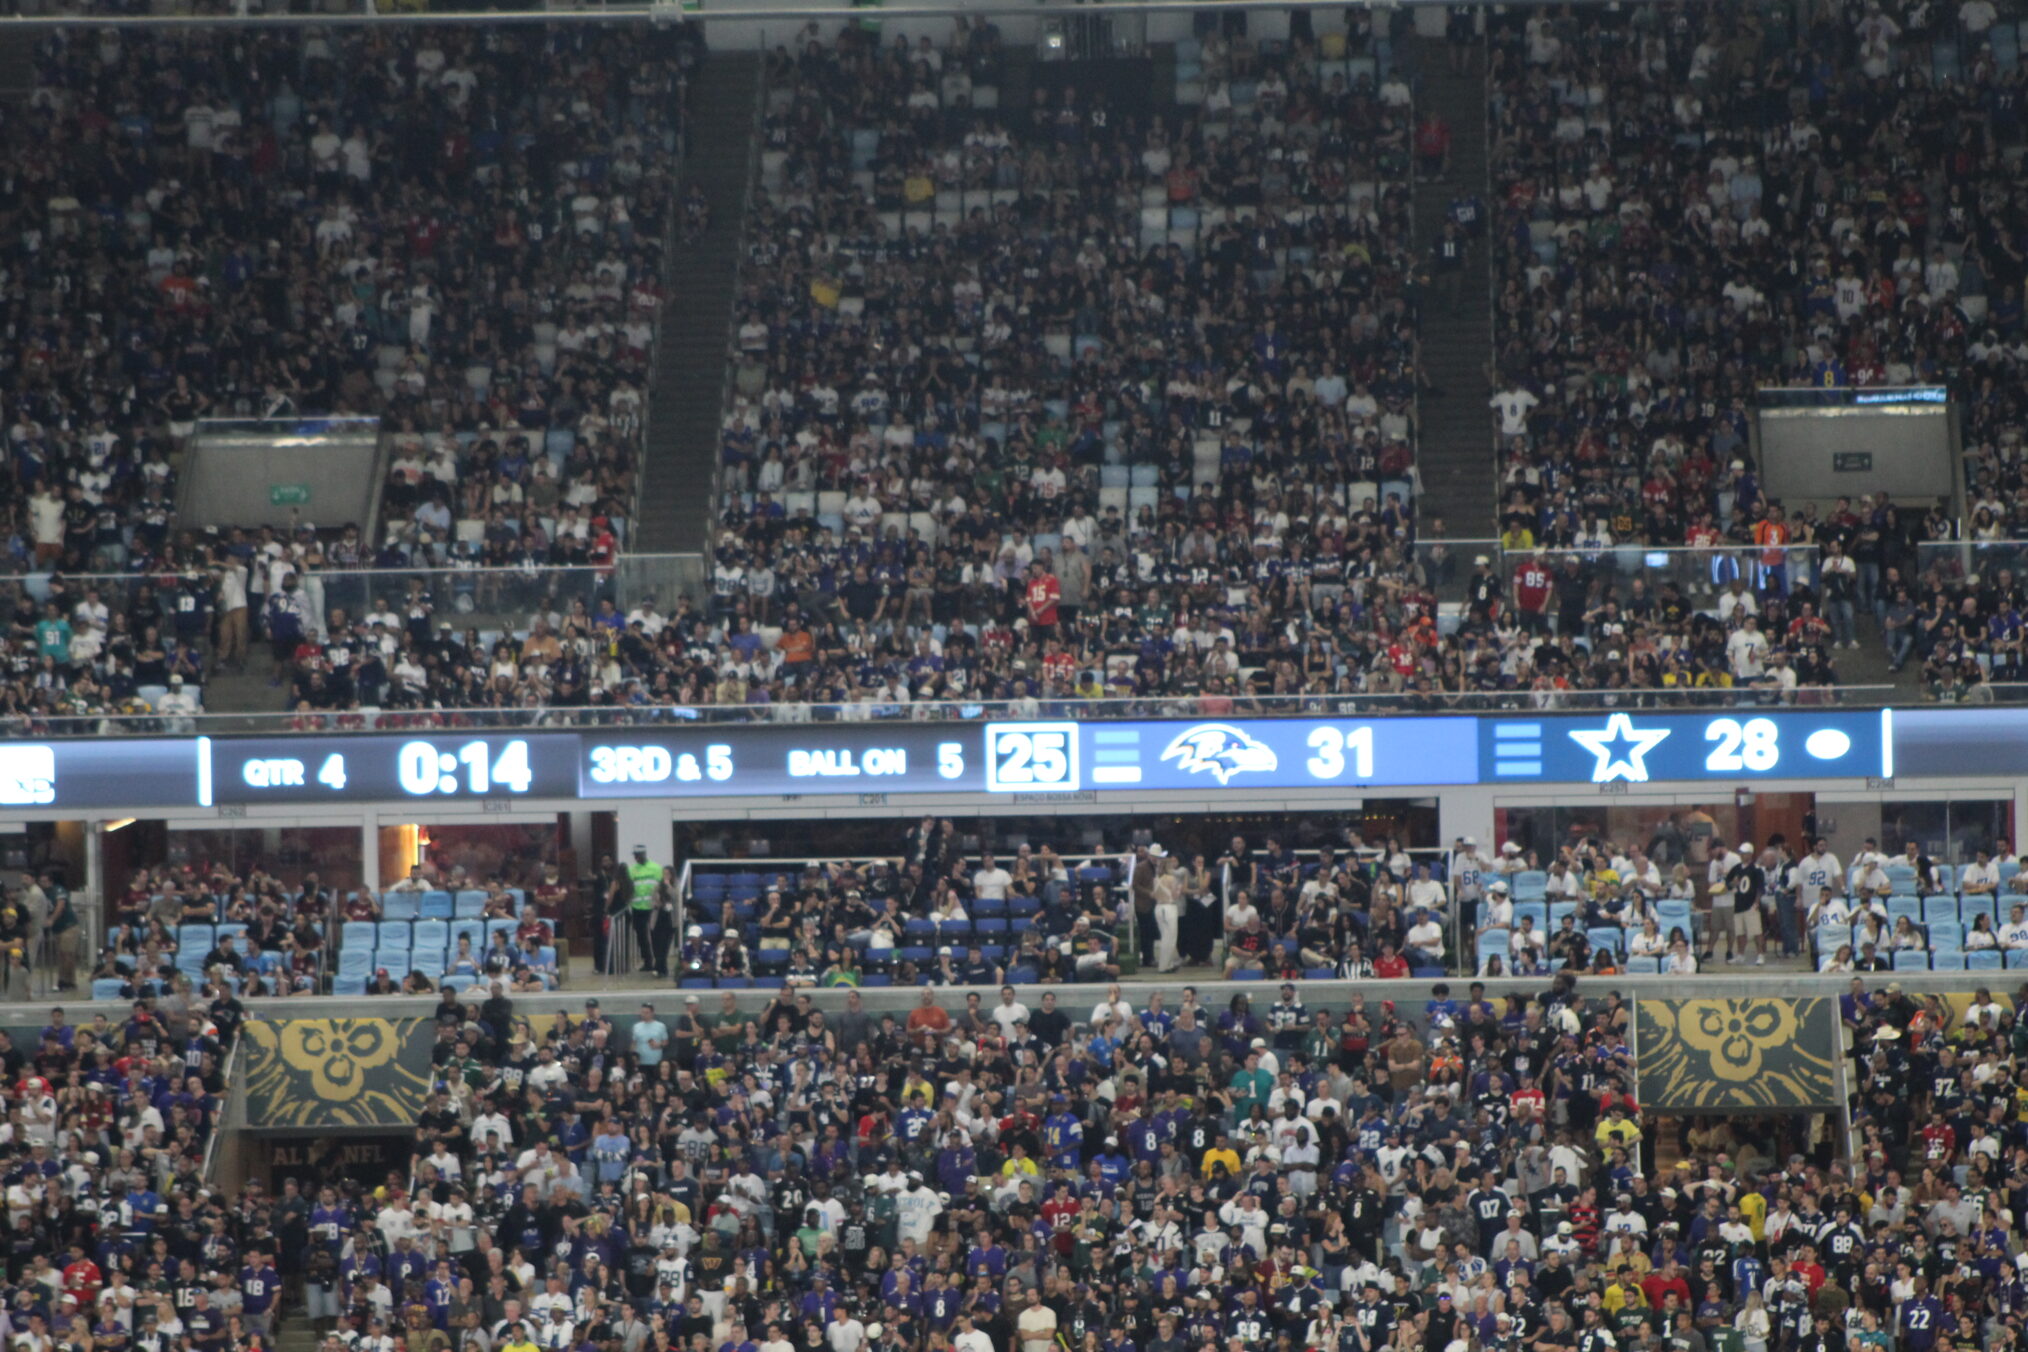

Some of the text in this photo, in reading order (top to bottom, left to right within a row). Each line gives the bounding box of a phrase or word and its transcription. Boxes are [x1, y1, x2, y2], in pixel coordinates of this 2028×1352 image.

[1824, 371, 1833, 386] 8
[1209, 411, 1221, 427] 11
[1525, 571, 1545, 587] 85
[1032, 584, 1046, 602] 15
[1479, 584, 1487, 600] 8
[45, 630, 60, 646] 91
[1745, 642, 1754, 658] 7
[1306, 725, 1374, 780] 31
[1705, 718, 1779, 771] 28
[591, 745, 734, 783] 3RD & 5
[789, 743, 964, 779] BALL ON 5
[996, 733, 1067, 783] 25
[244, 754, 347, 789] QTR 4
[399, 741, 532, 794] 0:14
[1463, 870, 1479, 885] 68
[1740, 876, 1750, 893] 0
[1809, 870, 1827, 885] 92
[1315, 1041, 1328, 1056] 11
[186, 1050, 201, 1067] 10
[1248, 1080, 1257, 1098] 1
[1582, 1074, 1595, 1090] 11
[1144, 1133, 1157, 1150] 8
[1194, 1130, 1204, 1147] 8
[1361, 1131, 1380, 1148] 22
[688, 1141, 707, 1158] 88
[1353, 1201, 1362, 1218] 8
[1480, 1200, 1500, 1218] 07
[1053, 1213, 1071, 1227] 12
[1833, 1236, 1853, 1253] 88
[935, 1299, 945, 1317] 8
[1909, 1309, 1931, 1329] 22
[1662, 1319, 1673, 1338] 1
[1583, 1335, 1593, 1351] 9
